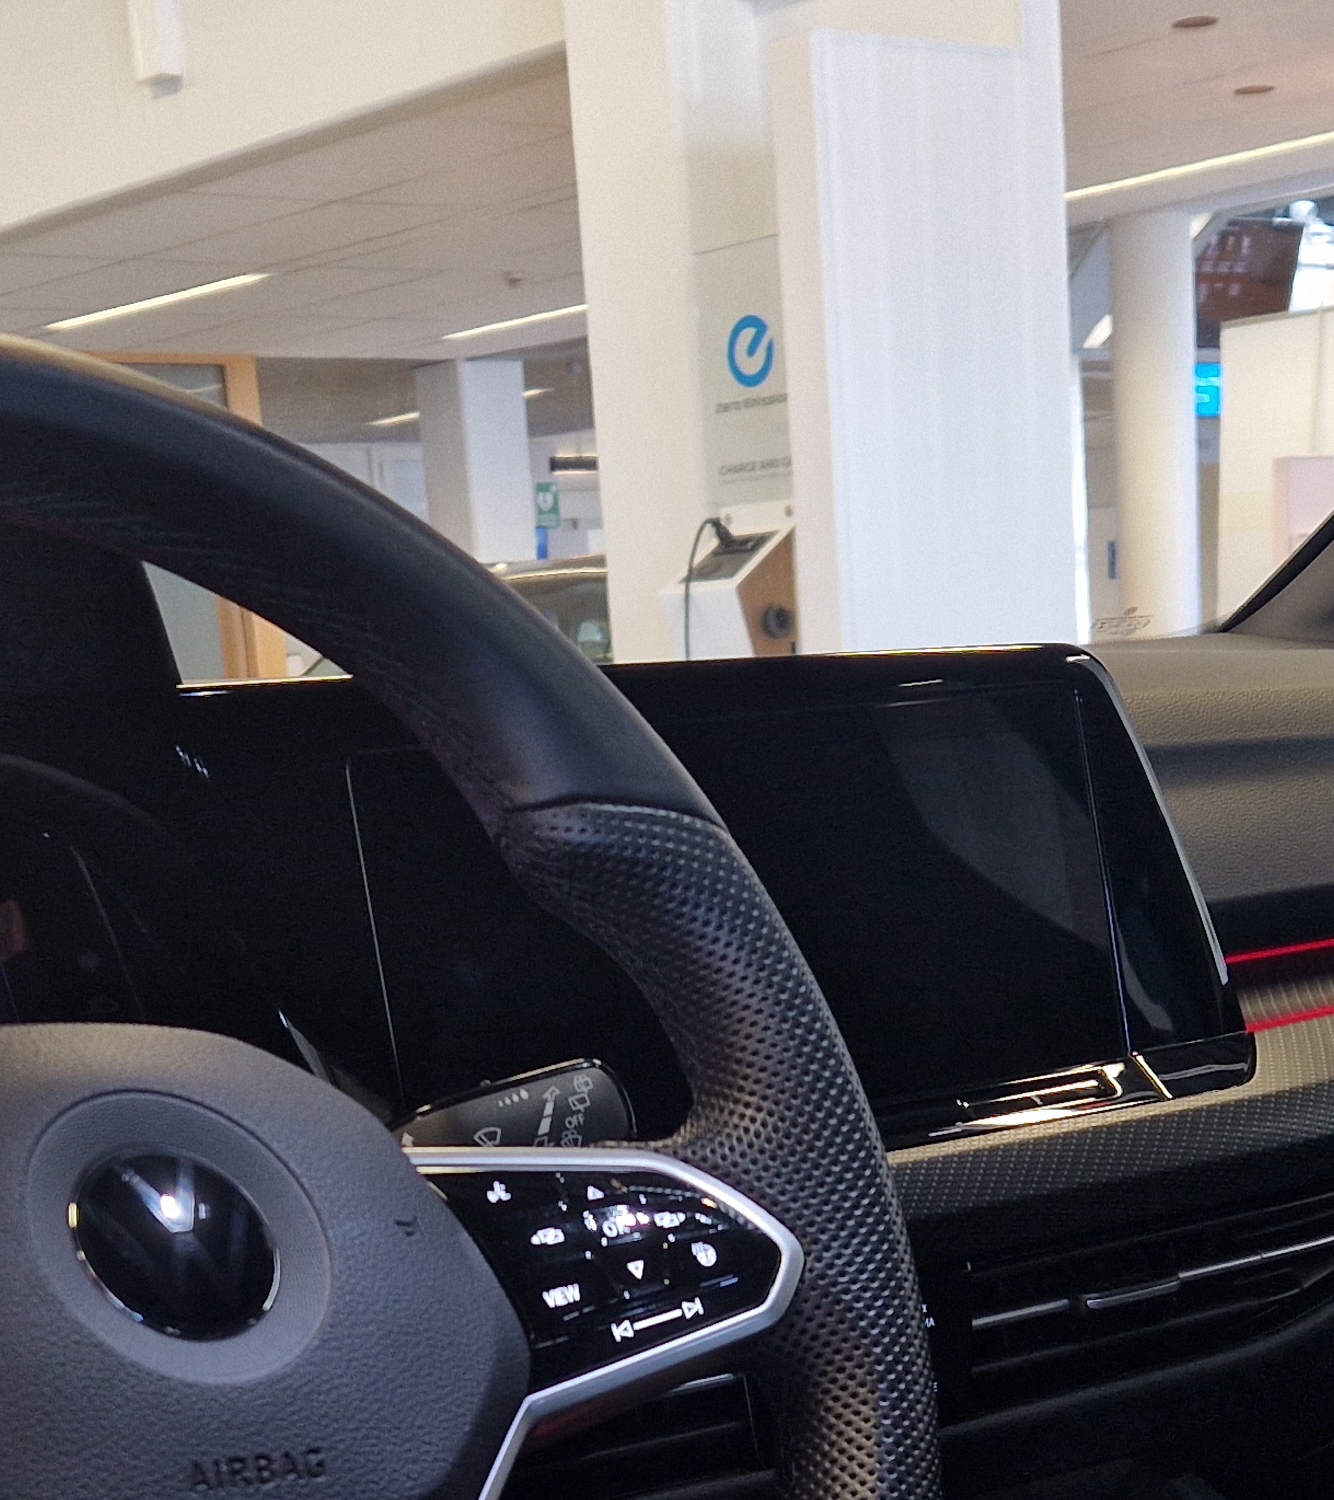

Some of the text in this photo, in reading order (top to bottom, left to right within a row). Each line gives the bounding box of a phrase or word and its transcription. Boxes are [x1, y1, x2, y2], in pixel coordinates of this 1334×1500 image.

[565, 1113, 585, 1129] OFF
[542, 1283, 581, 1309] VIEW
[189, 1448, 326, 1491] AIRBAG
